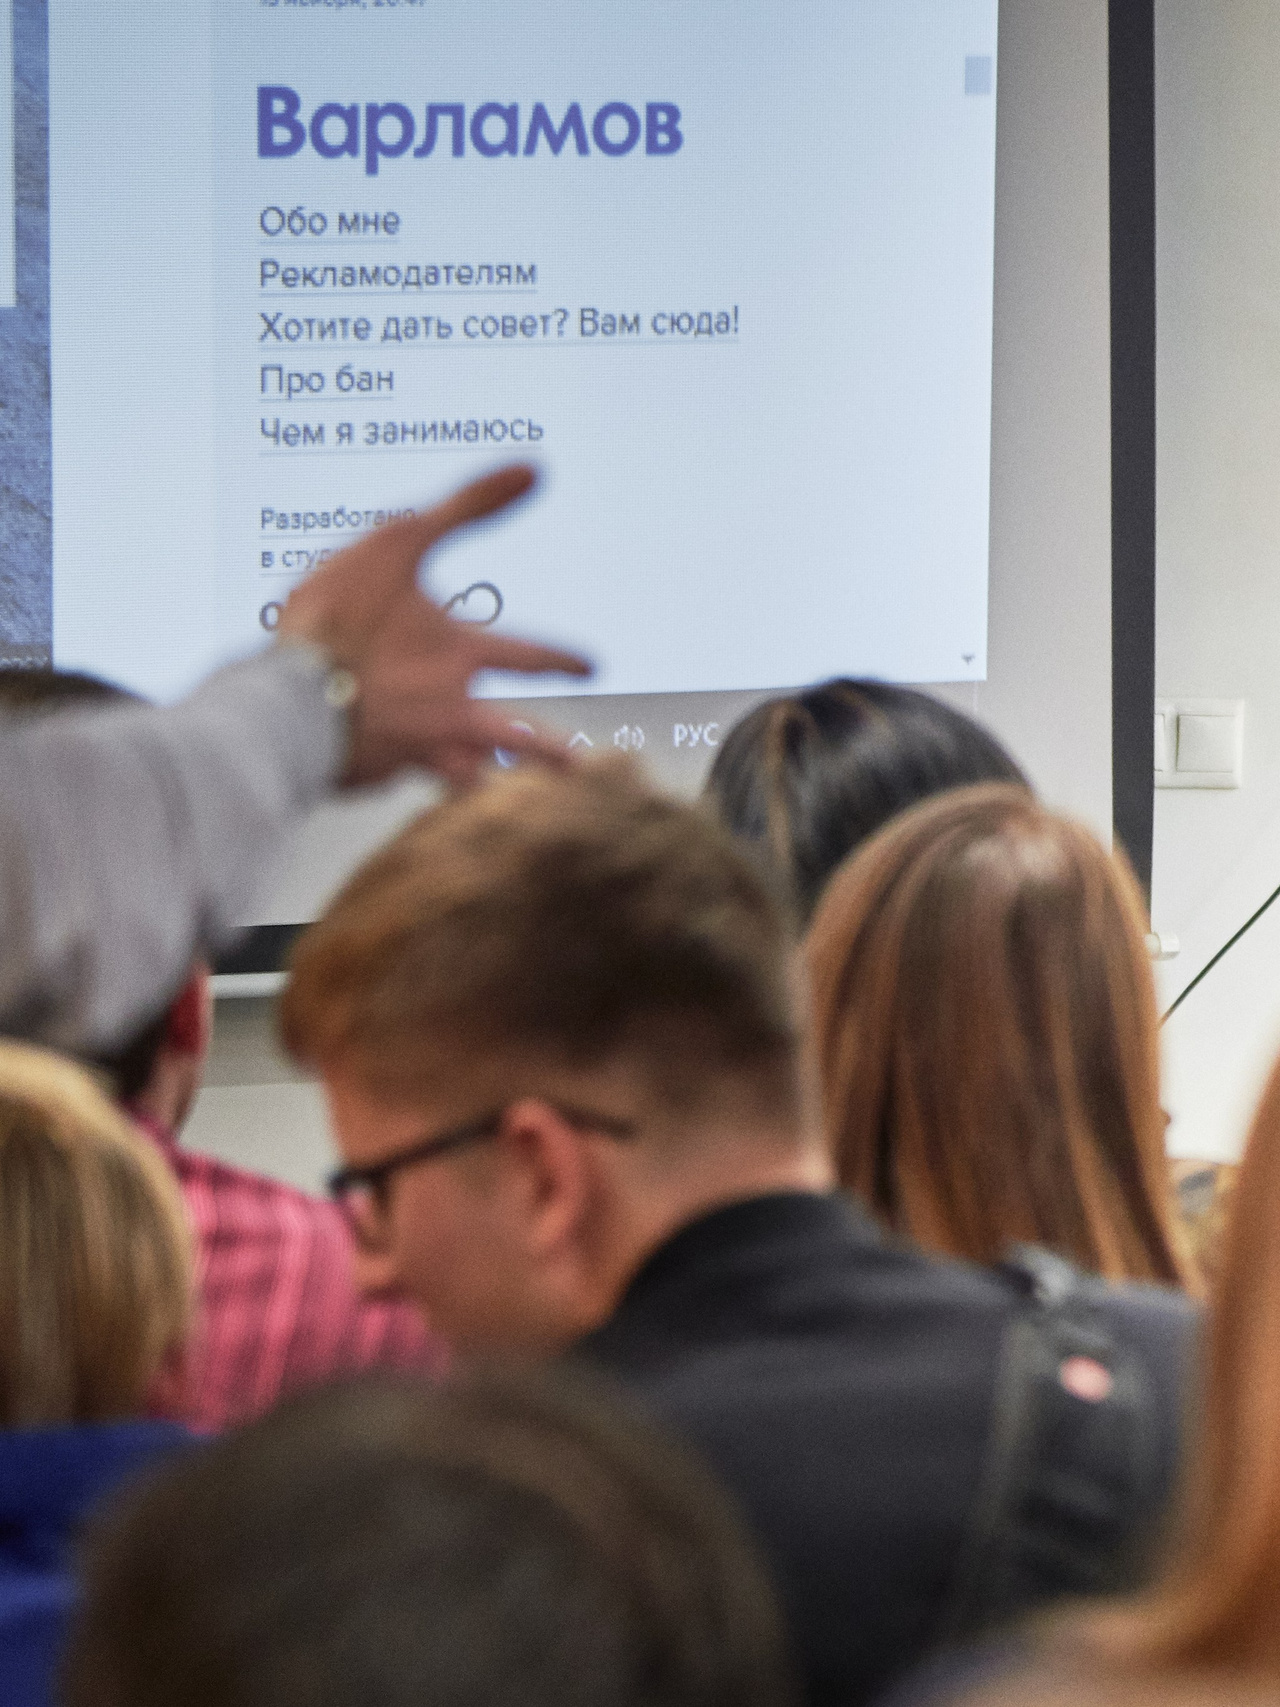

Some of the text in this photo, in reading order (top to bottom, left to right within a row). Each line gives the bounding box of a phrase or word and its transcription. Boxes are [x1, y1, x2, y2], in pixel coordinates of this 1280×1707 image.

[256, 84, 684, 176] Варламов
[259, 206, 401, 237] Обо мне
[259, 257, 537, 290] Рекламодателям
[259, 304, 739, 343] Хотите дать совет? Вам сюда!
[260, 363, 394, 397] Про бан
[260, 416, 544, 448] Чем я занимаюсь
[260, 551, 275, 568] в
[673, 722, 719, 748] РУС
